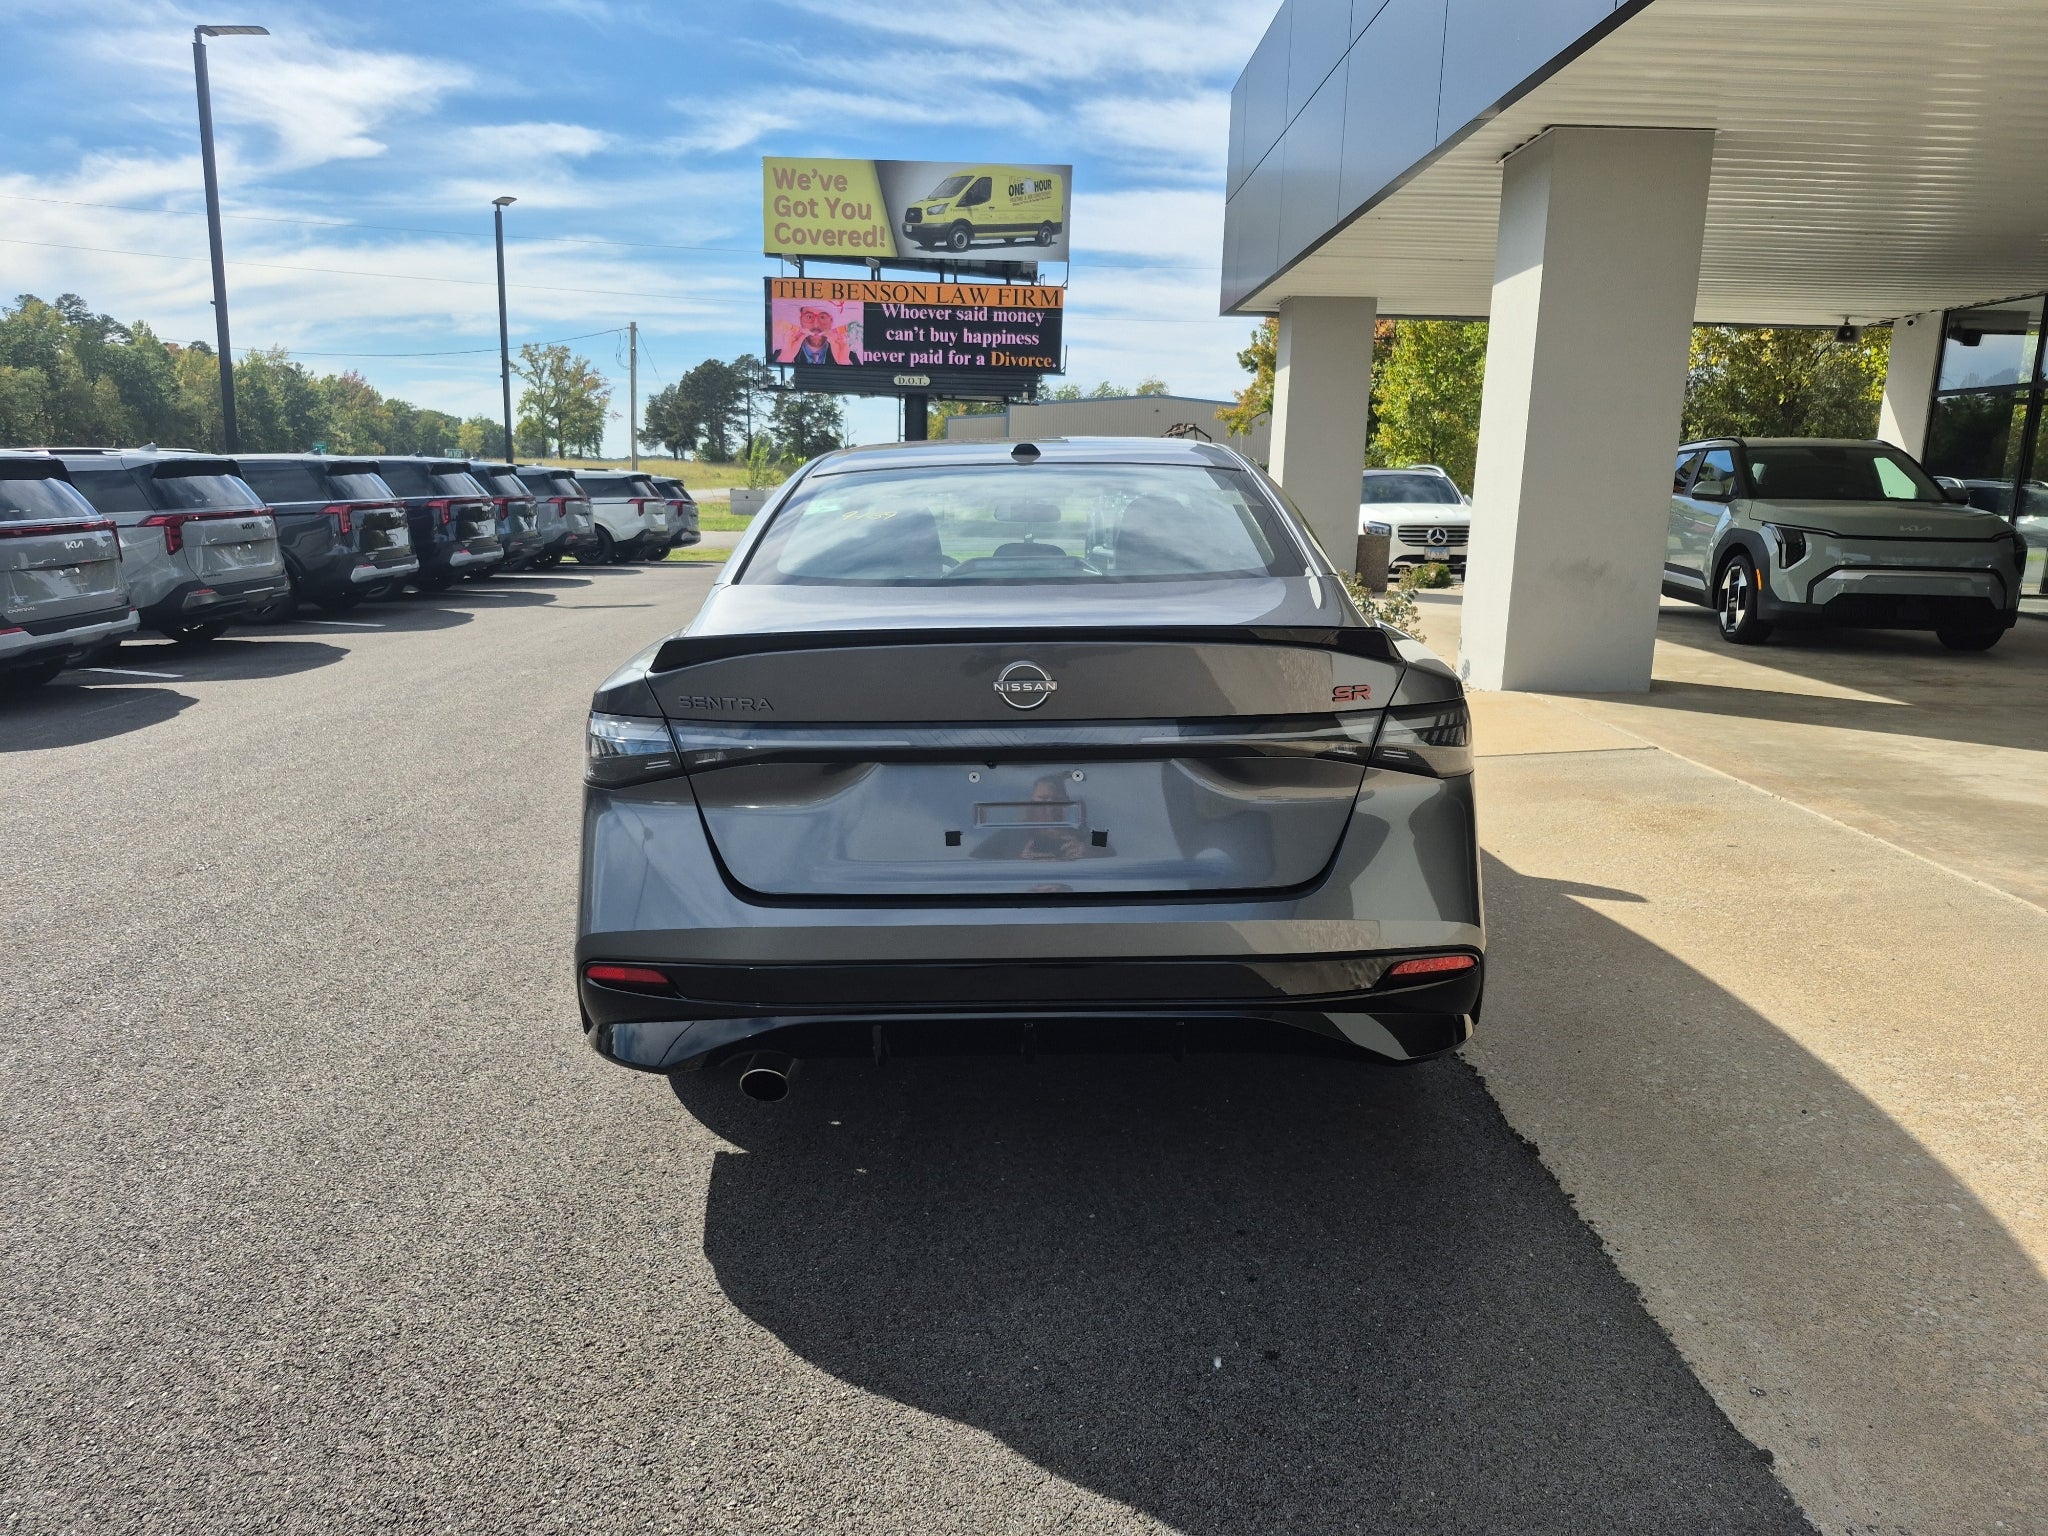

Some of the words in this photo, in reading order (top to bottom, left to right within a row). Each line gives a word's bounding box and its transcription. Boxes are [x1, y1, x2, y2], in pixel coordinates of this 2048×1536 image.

[773, 168, 848, 192] We've
[1008, 182, 1024, 196] ONE
[1034, 179, 1053, 192] HOUR
[774, 195, 819, 218] Got
[824, 197, 872, 220] You
[774, 222, 885, 247] Covered!
[775, 281, 824, 298] THE
[832, 283, 928, 303] BENSON
[936, 286, 990, 305] LAW
[997, 287, 1059, 307] FIRM
[881, 303, 952, 320] Whoever
[956, 306, 988, 321] said
[993, 310, 1045, 327] money
[886, 326, 926, 342] can't
[930, 327, 959, 346] buy
[963, 328, 1040, 348] happiness
[863, 351, 905, 363] never
[910, 349, 943, 367] paid
[948, 350, 971, 365] for
[976, 354, 985, 365] a
[991, 351, 1057, 368] Divorce.
[898, 377, 926, 385] D.O.T.
[64, 541, 84, 549] KIA
[994, 682, 1056, 692] NISSAN
[1332, 685, 1371, 702] SR
[679, 696, 775, 711] SENTRA
